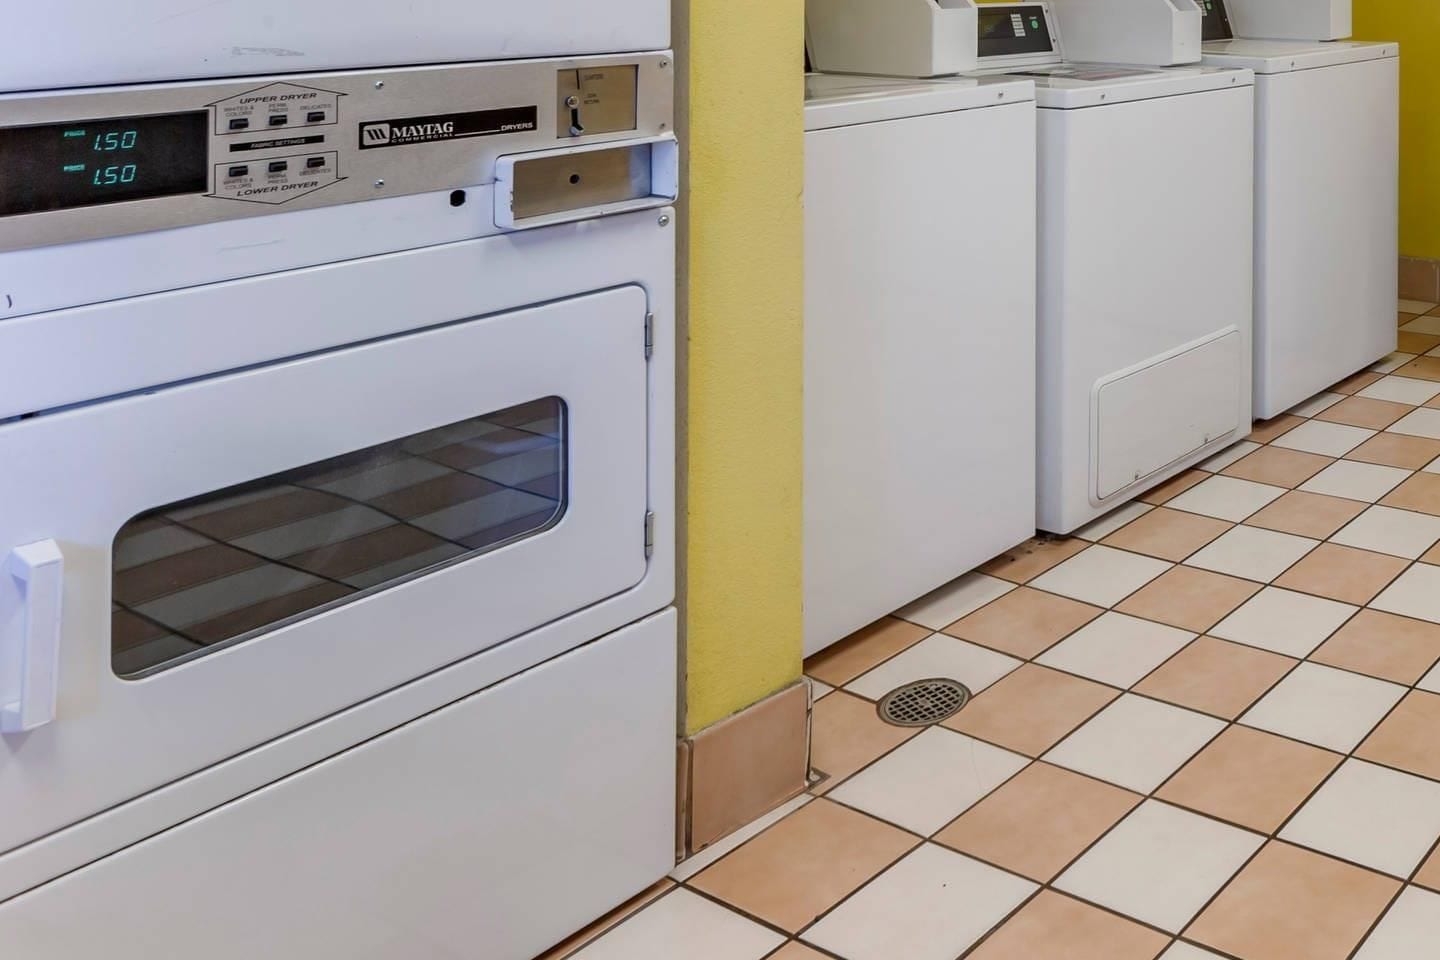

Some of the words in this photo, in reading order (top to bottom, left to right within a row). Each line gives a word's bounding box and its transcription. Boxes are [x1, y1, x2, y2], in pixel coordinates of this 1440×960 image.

[240, 95, 277, 105] UPPER
[280, 92, 318, 101] DRYER
[391, 122, 454, 139] MAYTAG
[391, 134, 455, 143] COMMERCIAL
[501, 122, 533, 132] DRYERS
[94, 130, 137, 150] 1.50
[93, 165, 137, 185] 1.50
[237, 186, 279, 197] LOWER
[281, 181, 319, 192] DRYER
